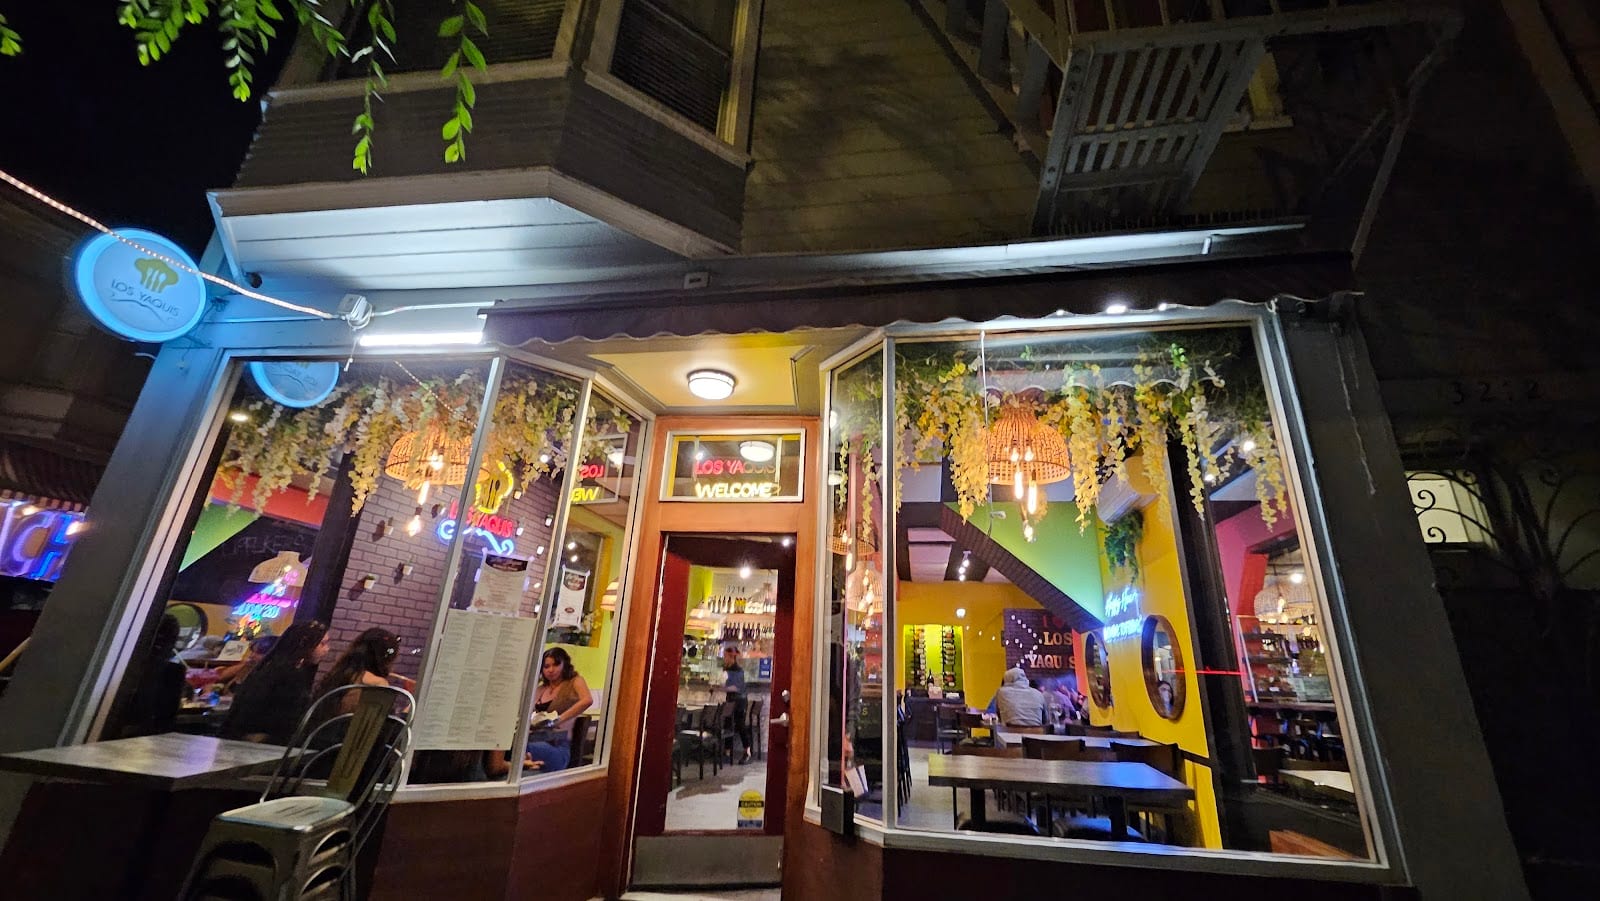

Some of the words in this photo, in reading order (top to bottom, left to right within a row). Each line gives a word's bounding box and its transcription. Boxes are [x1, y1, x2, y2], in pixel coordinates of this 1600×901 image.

[111, 279, 135, 297] LOS
[139, 292, 181, 317] YAQUIS
[694, 459, 724, 475] LOS
[726, 459, 776, 474] YAQUIS
[694, 481, 774, 499] WELCOME
[1043, 631, 1073, 646] LOS
